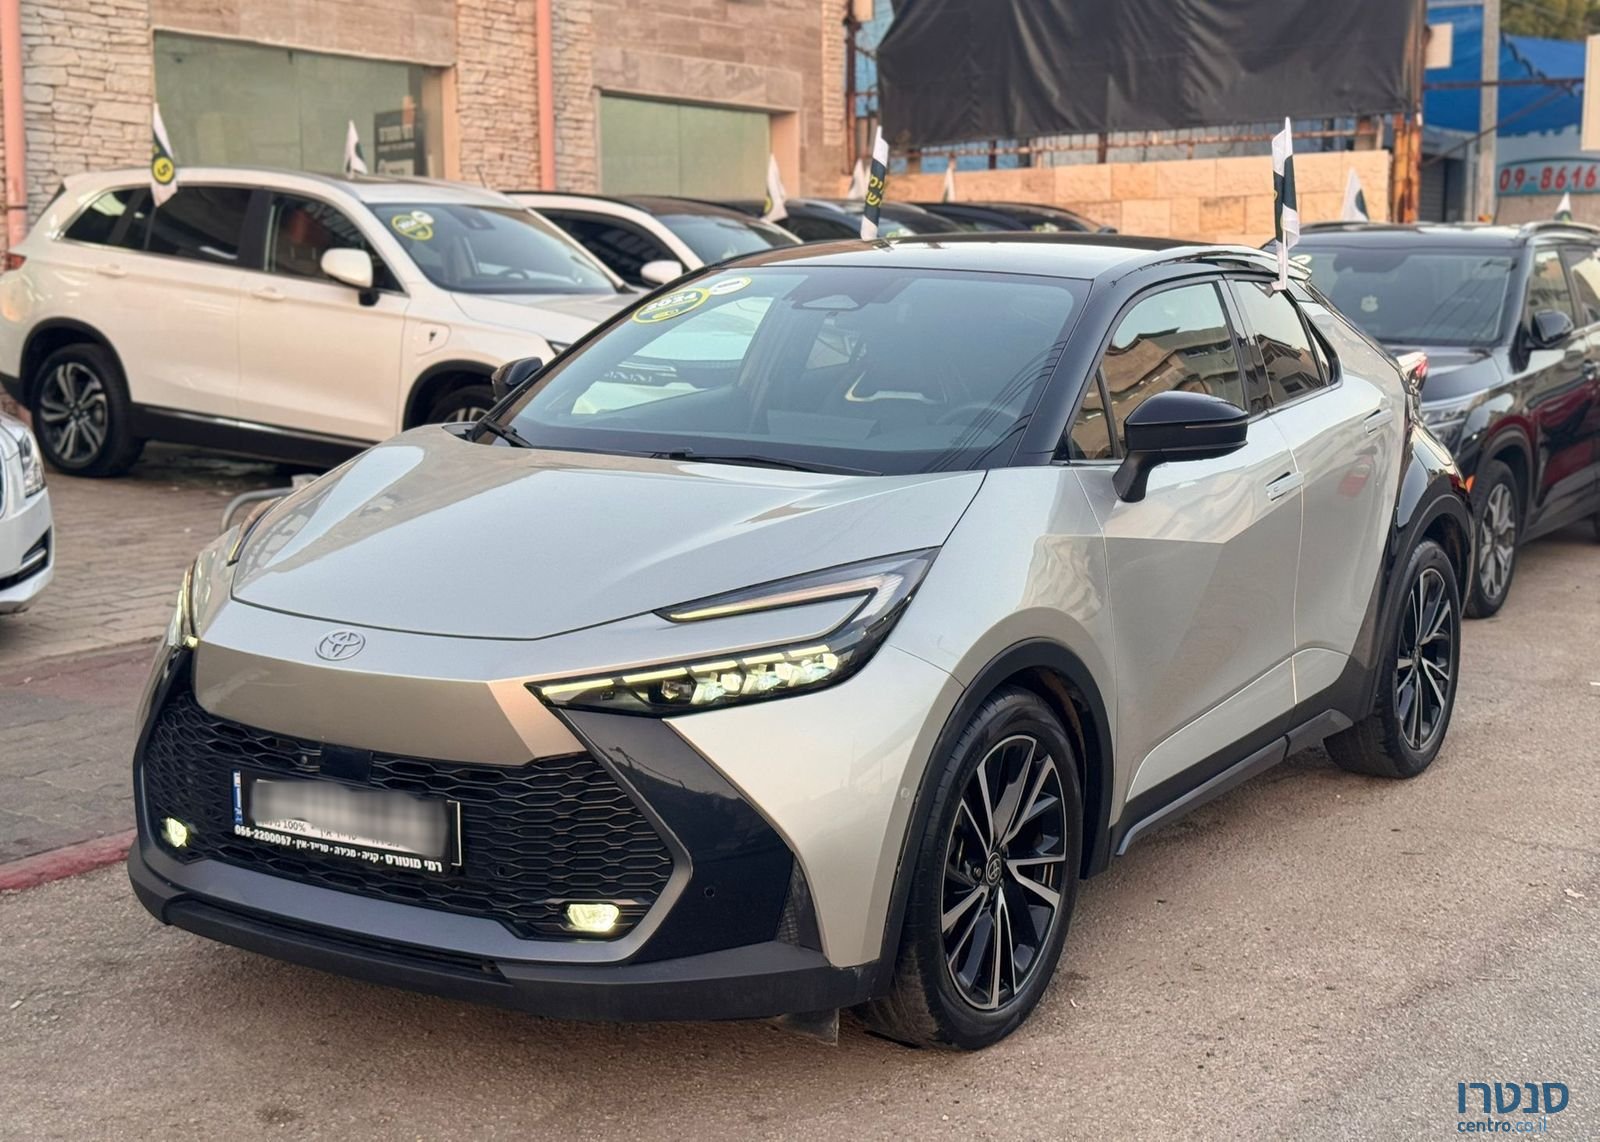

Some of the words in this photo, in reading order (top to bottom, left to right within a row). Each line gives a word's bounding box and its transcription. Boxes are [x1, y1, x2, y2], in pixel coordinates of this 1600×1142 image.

[361, 851, 379, 864] קניה
[385, 854, 421, 869] מוטורס
[424, 859, 442, 873] רמי
